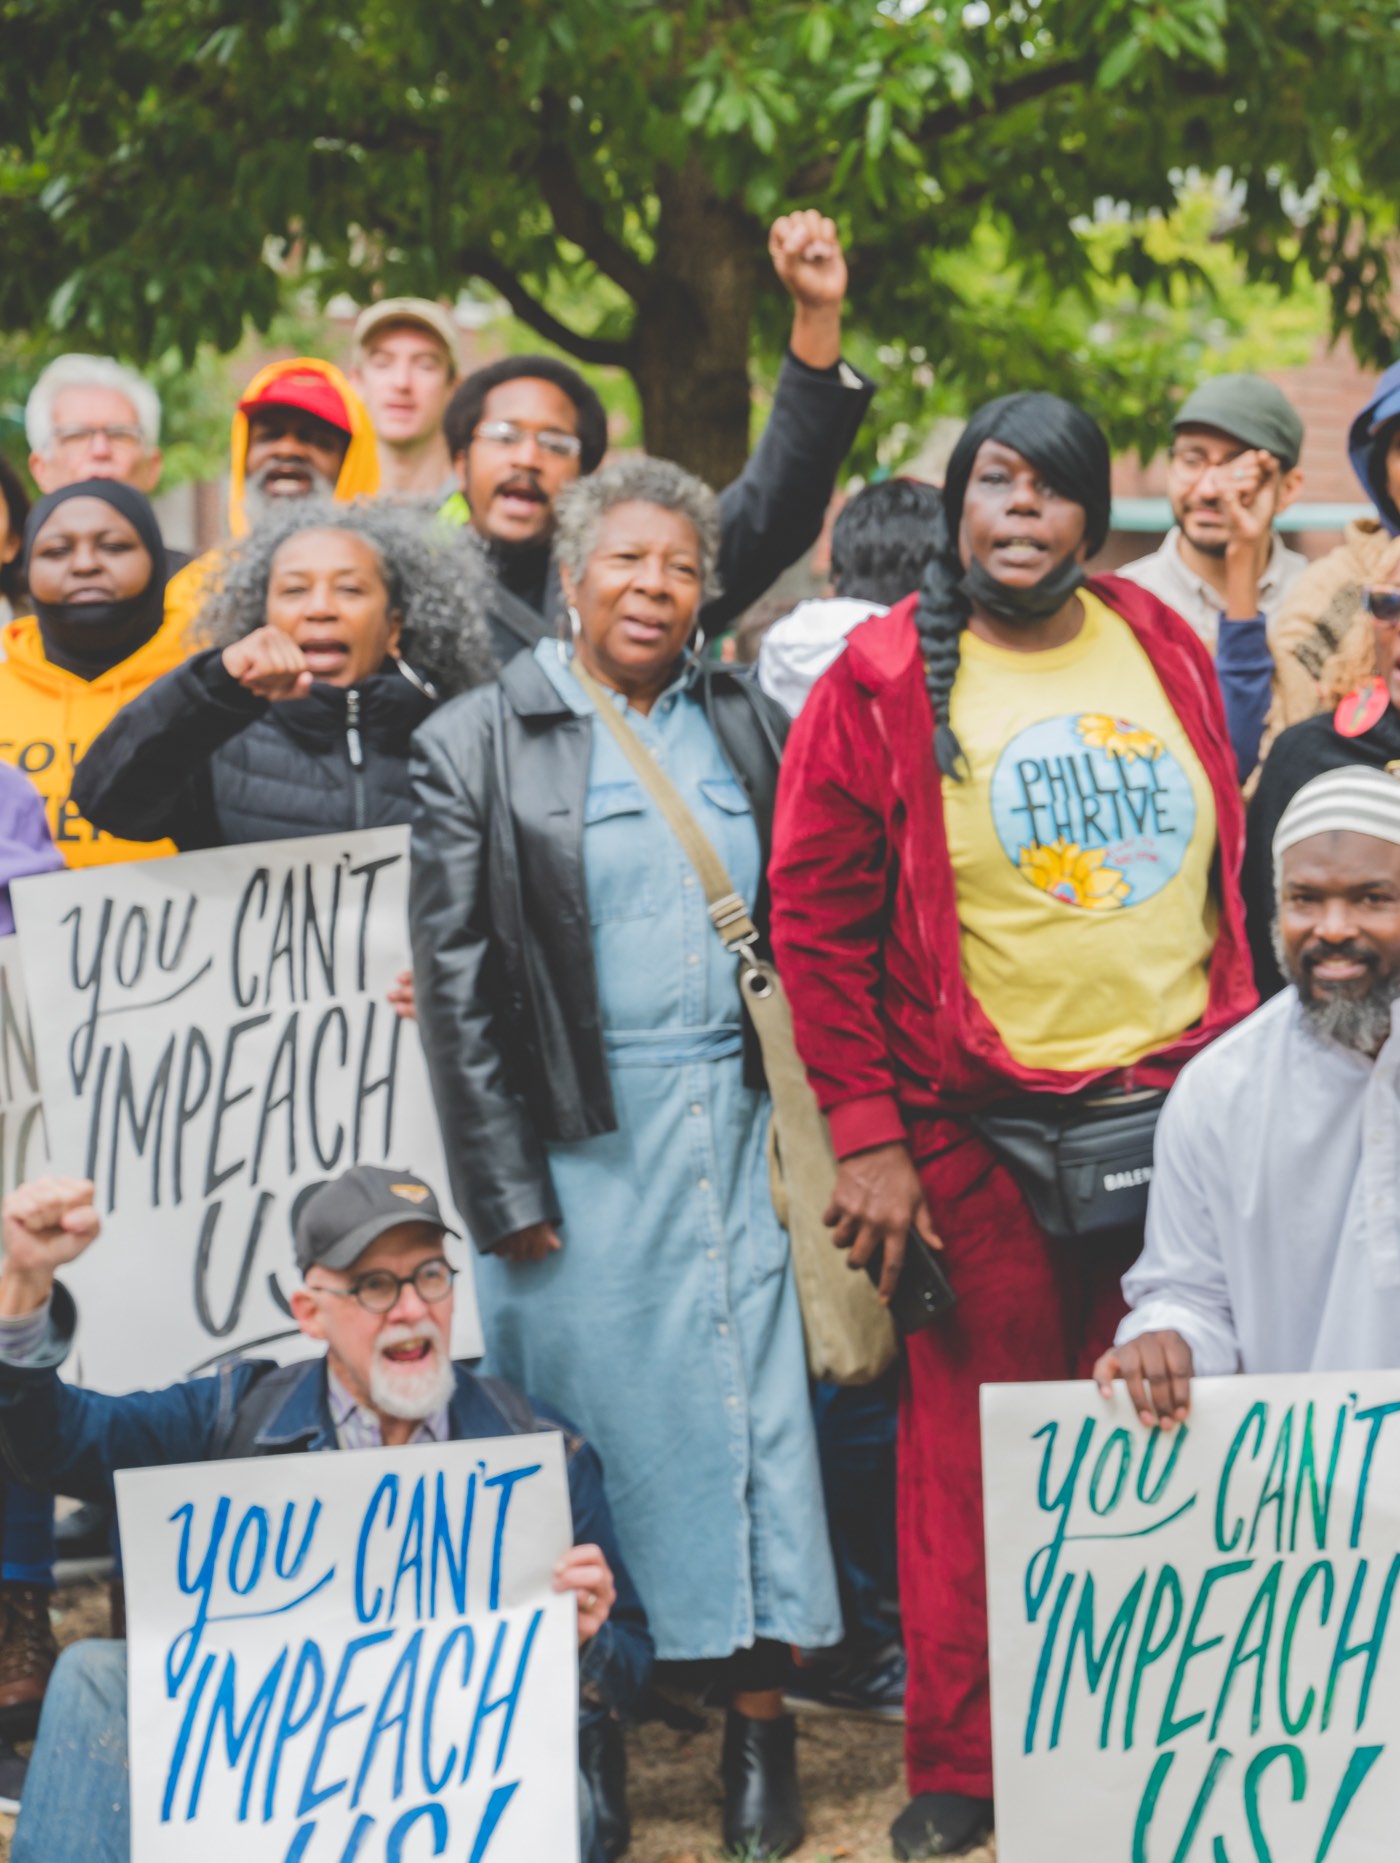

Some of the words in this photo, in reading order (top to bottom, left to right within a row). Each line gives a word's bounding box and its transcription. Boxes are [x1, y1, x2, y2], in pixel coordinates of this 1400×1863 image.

[1010, 786, 1176, 850] THRIVE
[1017, 748, 1169, 801] PHILLY
[231, 853, 401, 1008] CAN'T
[86, 1000, 401, 1213] IMPEACH
[354, 1461, 542, 1623] CAN'T
[160, 1609, 544, 1822] IMPEACH
